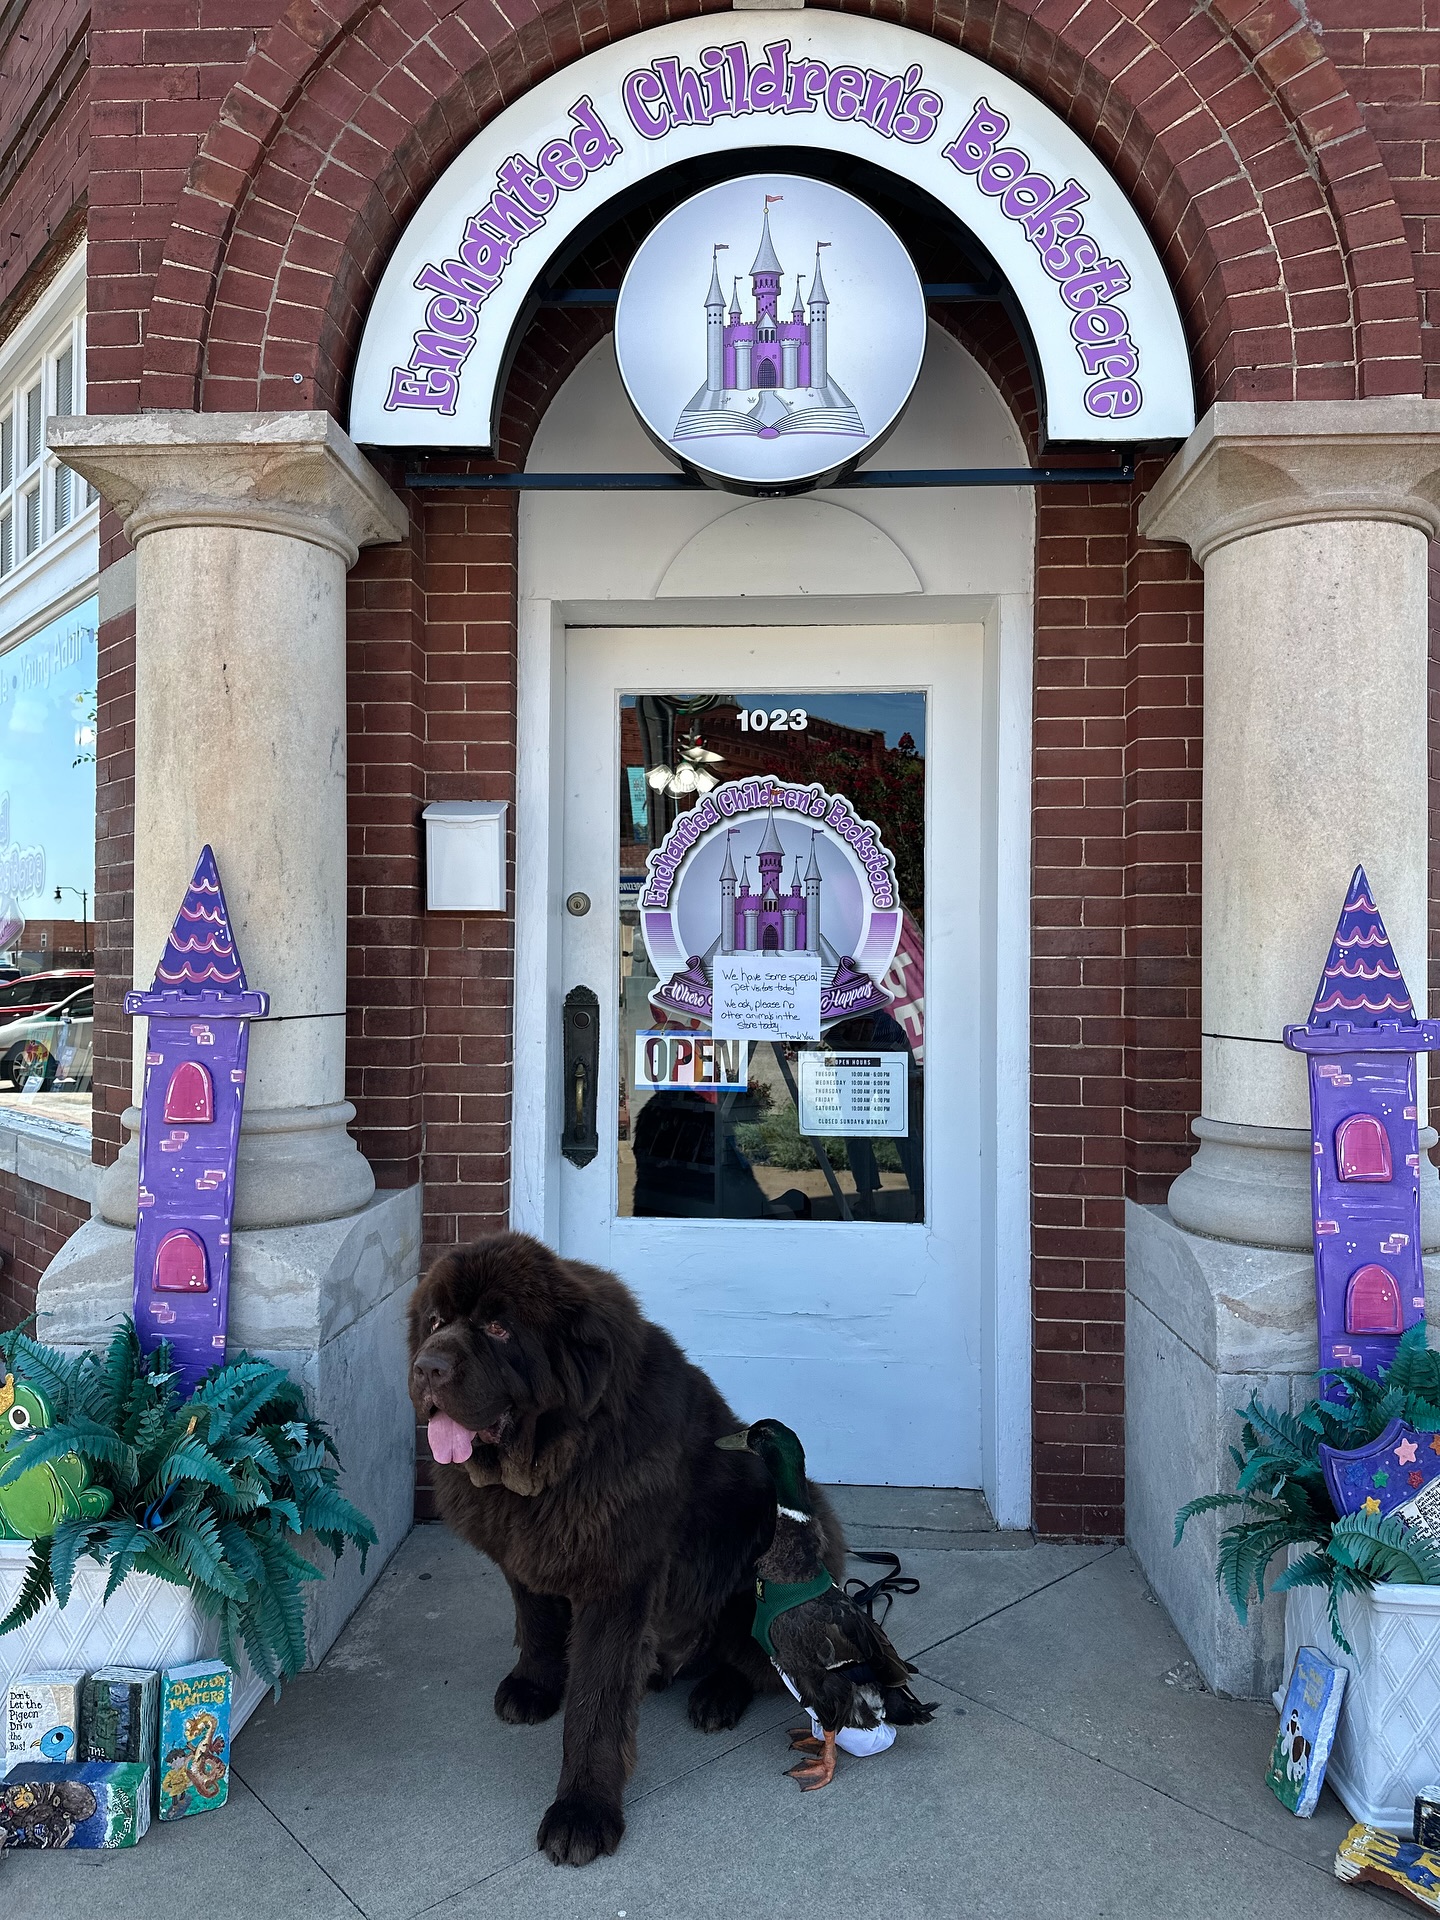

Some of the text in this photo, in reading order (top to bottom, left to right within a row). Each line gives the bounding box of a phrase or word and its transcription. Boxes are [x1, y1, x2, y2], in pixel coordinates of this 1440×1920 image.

[385, 39, 1143, 419] Enchanted Children's Bookstore
[20, 651, 50, 692] Young
[54, 621, 84, 674] Adult
[736, 708, 808, 732] 1023
[643, 780, 894, 909] Enchanted Children's Bookstore
[722, 968, 817, 987] We have some special
[661, 982, 705, 1007] Where
[731, 983, 749, 995] pet
[751, 983, 774, 992] visitors
[821, 981, 873, 1012] Happens
[724, 999, 737, 1008] We
[755, 999, 781, 1012] please
[783, 1000, 795, 1009] no
[721, 1011, 742, 1019] other
[746, 1011, 774, 1020] animals
[737, 1020, 758, 1029] store
[777, 1032, 815, 1041] Thank You
[644, 1038, 740, 1083] OPEN
[170, 1675, 227, 1696] DRAGON
[10, 1691, 30, 1700] Don't
[10, 1699, 42, 1709] Let the
[9, 1710, 38, 1722] Pigeon
[9, 1722, 32, 1731] Drive
[8, 1732, 22, 1741] the
[10, 1742, 26, 1751] Bus!
[89, 1746, 106, 1757] THE
[116, 1788, 131, 1808] MAGIC
